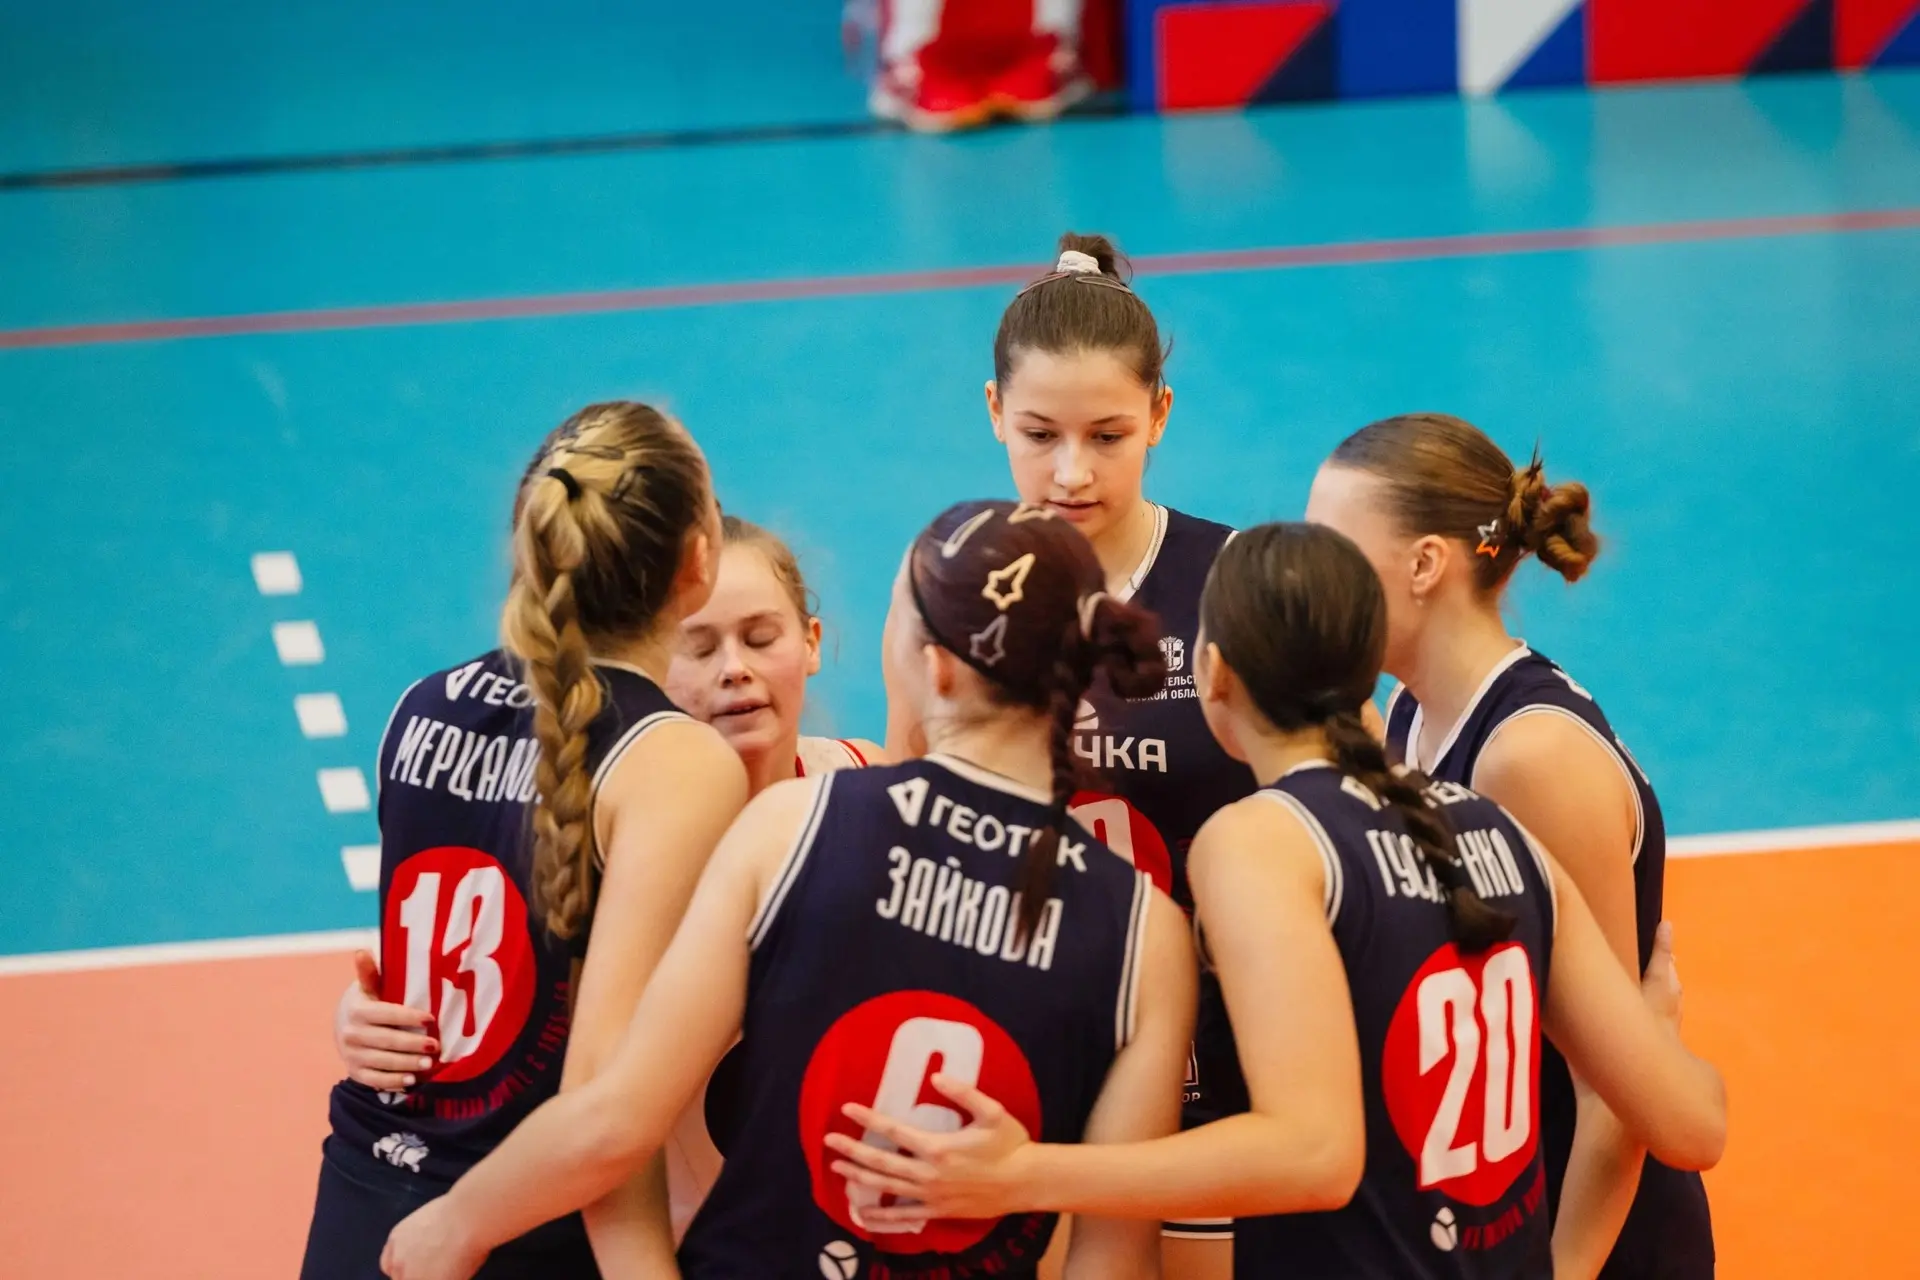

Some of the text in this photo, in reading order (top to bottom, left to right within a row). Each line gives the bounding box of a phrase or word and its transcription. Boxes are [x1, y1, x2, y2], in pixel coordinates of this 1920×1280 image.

[468, 671, 538, 708] ГЕО
[1073, 735, 1168, 773] ЧКА
[929, 794, 1088, 873] ГЕОТК
[400, 865, 505, 1063] 13
[845, 1016, 985, 1234] 6
[1416, 945, 1534, 1187] 20
